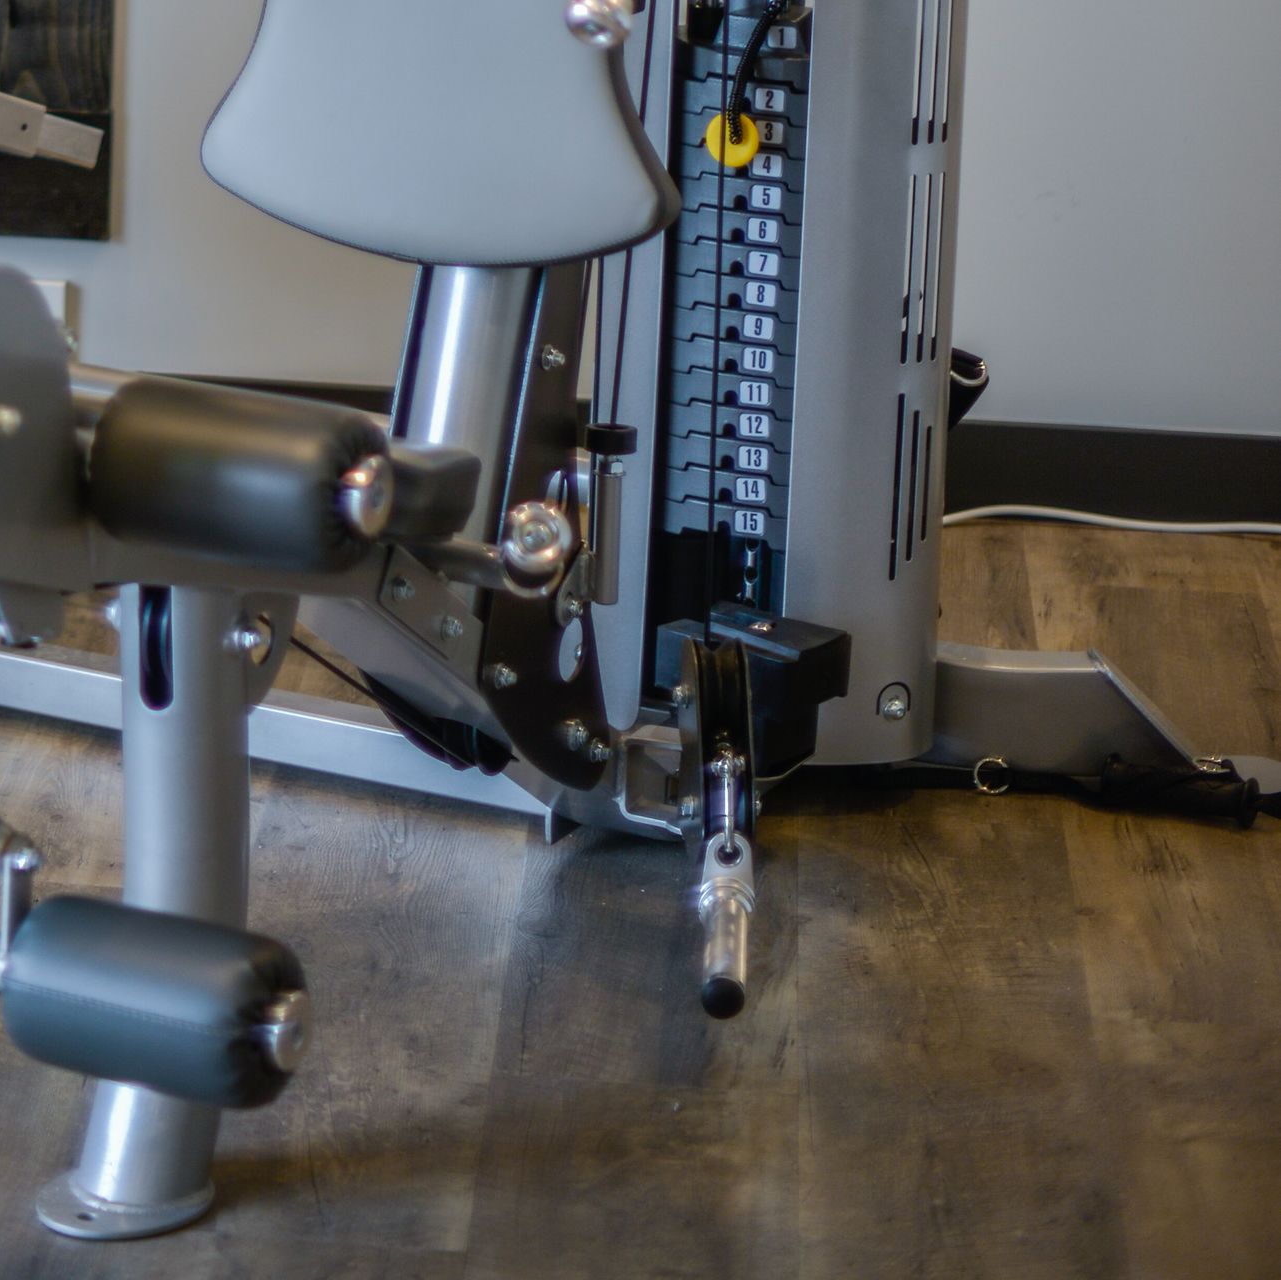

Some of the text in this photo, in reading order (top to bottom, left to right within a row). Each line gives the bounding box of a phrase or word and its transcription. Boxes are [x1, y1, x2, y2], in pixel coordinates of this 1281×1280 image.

[765, 90, 774, 109] 2
[764, 122, 773, 141] 3
[762, 155, 771, 174] 4
[762, 188, 771, 206] 5
[758, 220, 767, 239] 6
[759, 254, 767, 272] 7
[756, 284, 765, 303] 8
[754, 317, 763, 336] 9
[750, 350, 766, 369] 10
[747, 383, 762, 402] 11
[746, 415, 763, 435] 12
[745, 448, 761, 467] 13
[742, 480, 759, 498] 14
[741, 512, 758, 531] 15
